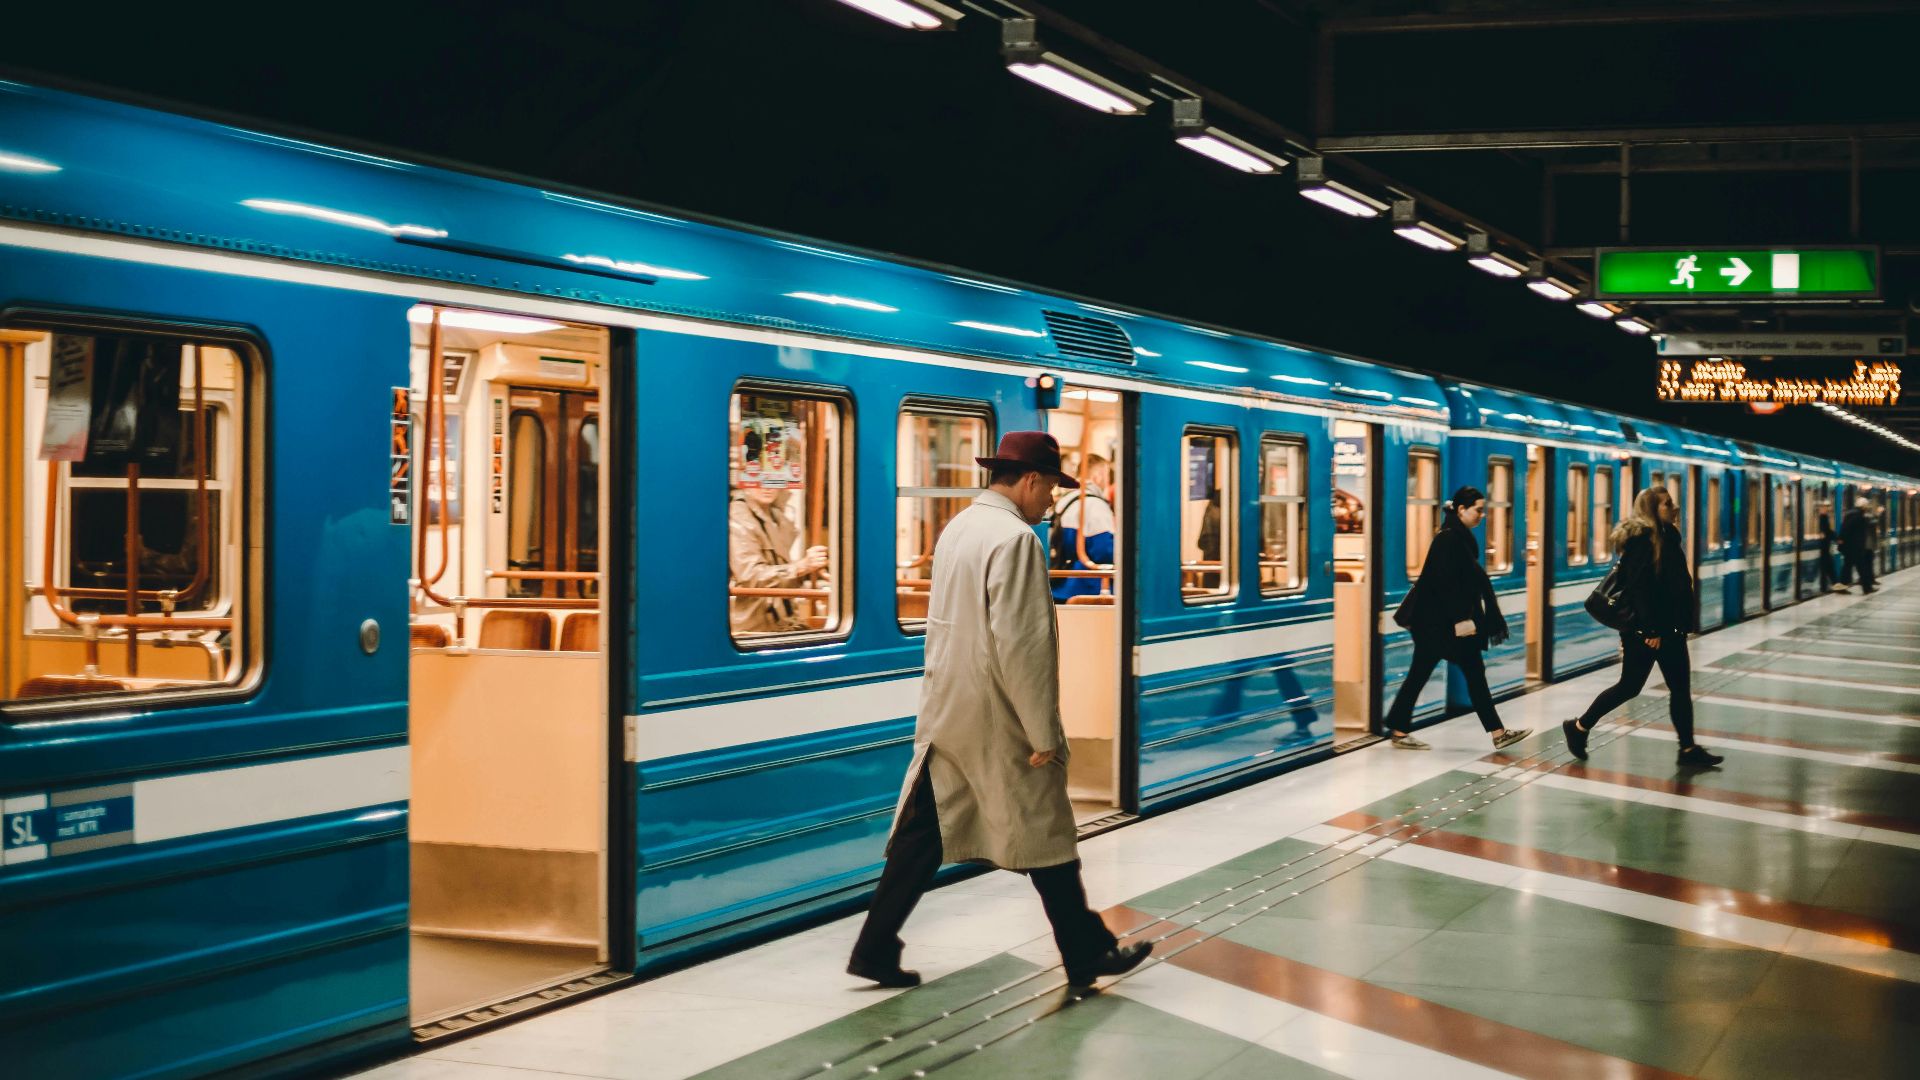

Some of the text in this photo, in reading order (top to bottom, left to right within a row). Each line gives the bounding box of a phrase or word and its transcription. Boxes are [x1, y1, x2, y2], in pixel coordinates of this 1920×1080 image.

[1691, 360, 1746, 382] Akalla
[1868, 361, 1901, 382] min
[12, 815, 38, 845] SL
